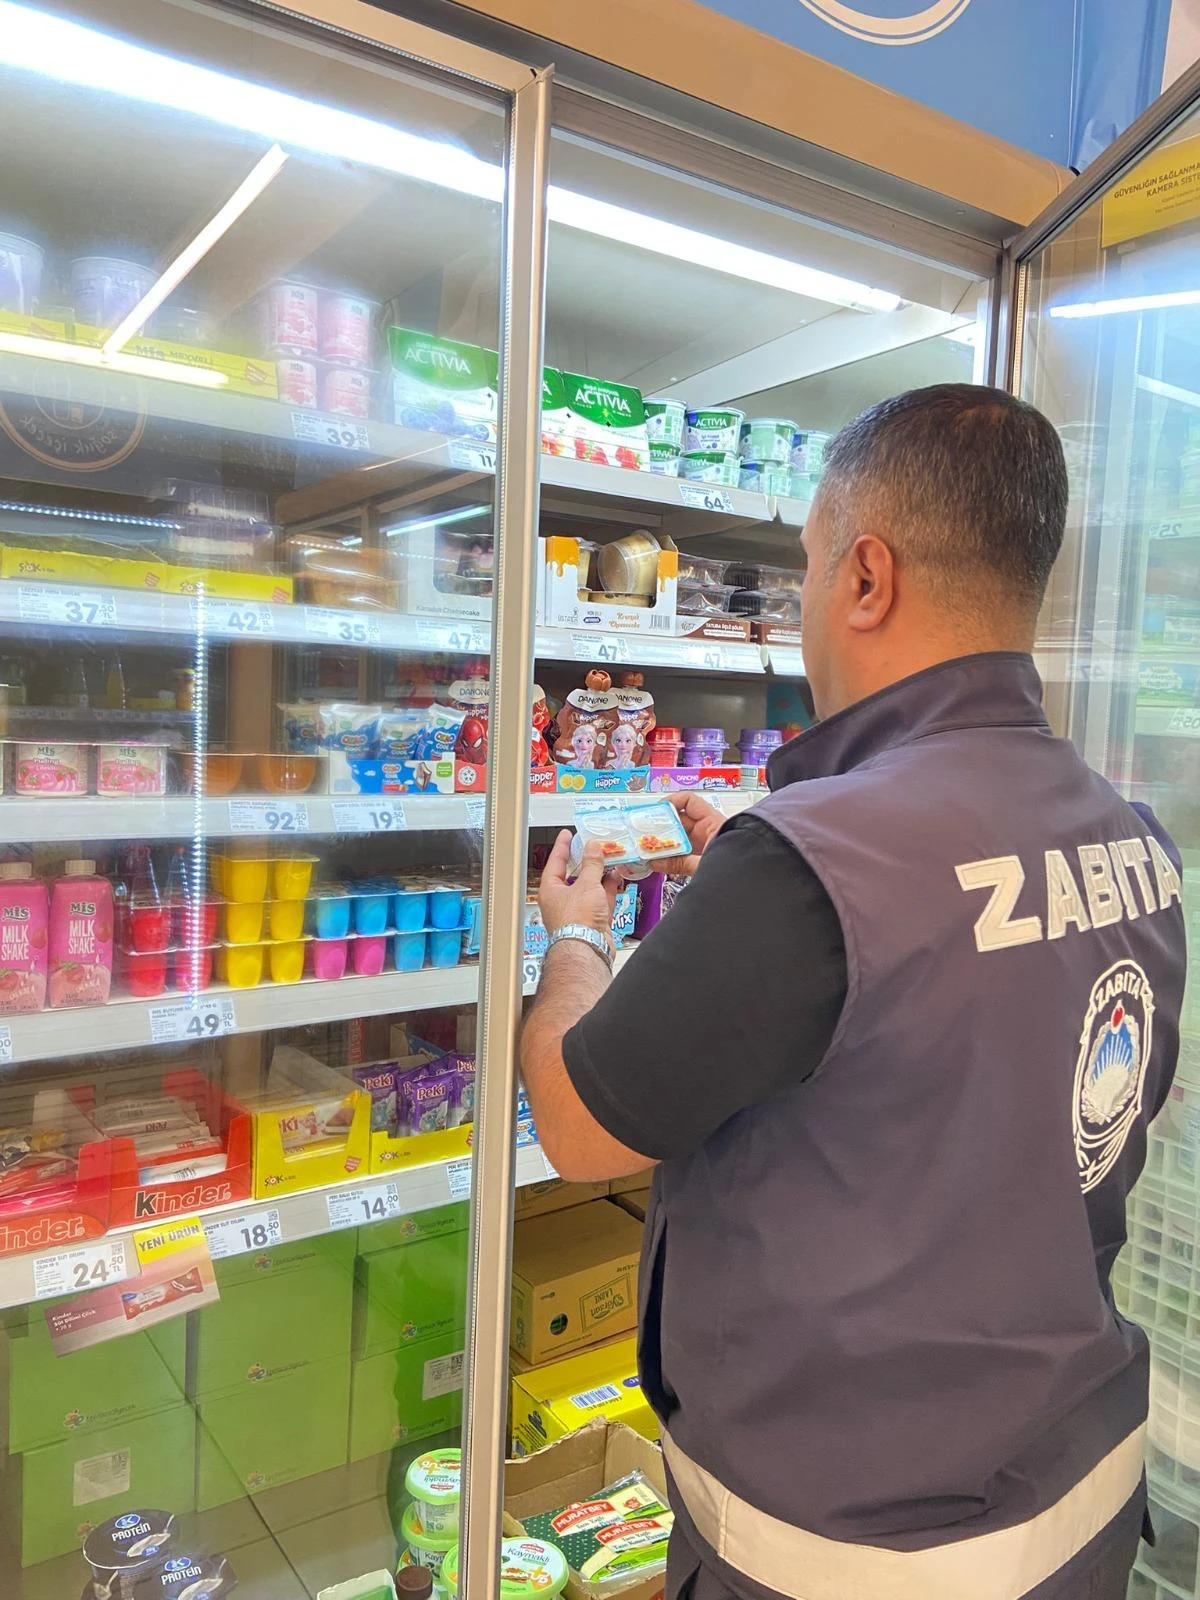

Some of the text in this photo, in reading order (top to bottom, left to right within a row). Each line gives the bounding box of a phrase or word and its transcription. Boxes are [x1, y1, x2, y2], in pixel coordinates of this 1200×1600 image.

[404, 346, 472, 375] ACTIVIA
[575, 388, 631, 413] ACTIVIA
[696, 418, 727, 427] ACTIVIA
[327, 427, 355, 447] 39
[704, 496, 724, 510] 64
[65, 601, 99, 624] 37
[228, 612, 258, 631] 42
[339, 622, 366, 641] 35
[449, 632, 471, 649] 47
[598, 645, 617, 660] 47
[617, 694, 643, 703] ANONE
[265, 811, 294, 830] 92
[369, 811, 392, 829] 19
[955, 836, 1182, 952] ZABITA
[2, 925, 29, 943] MILK
[69, 920, 95, 937] MILK
[2, 943, 29, 961] SHAKE
[68, 937, 95, 954] SHAKE
[1095, 971, 1141, 1012] ZABITA
[187, 1014, 219, 1036] 49
[134, 1183, 229, 1219] Kinder
[361, 1197, 387, 1220] 14
[0, 1216, 83, 1251] inder
[138, 1224, 200, 1251] YENİ ÜRÜN
[241, 1224, 268, 1249] 18
[73, 1259, 109, 1287] 24
[556, 1502, 608, 1528] MURATBEY
[601, 1520, 655, 1541] MURATBEY
